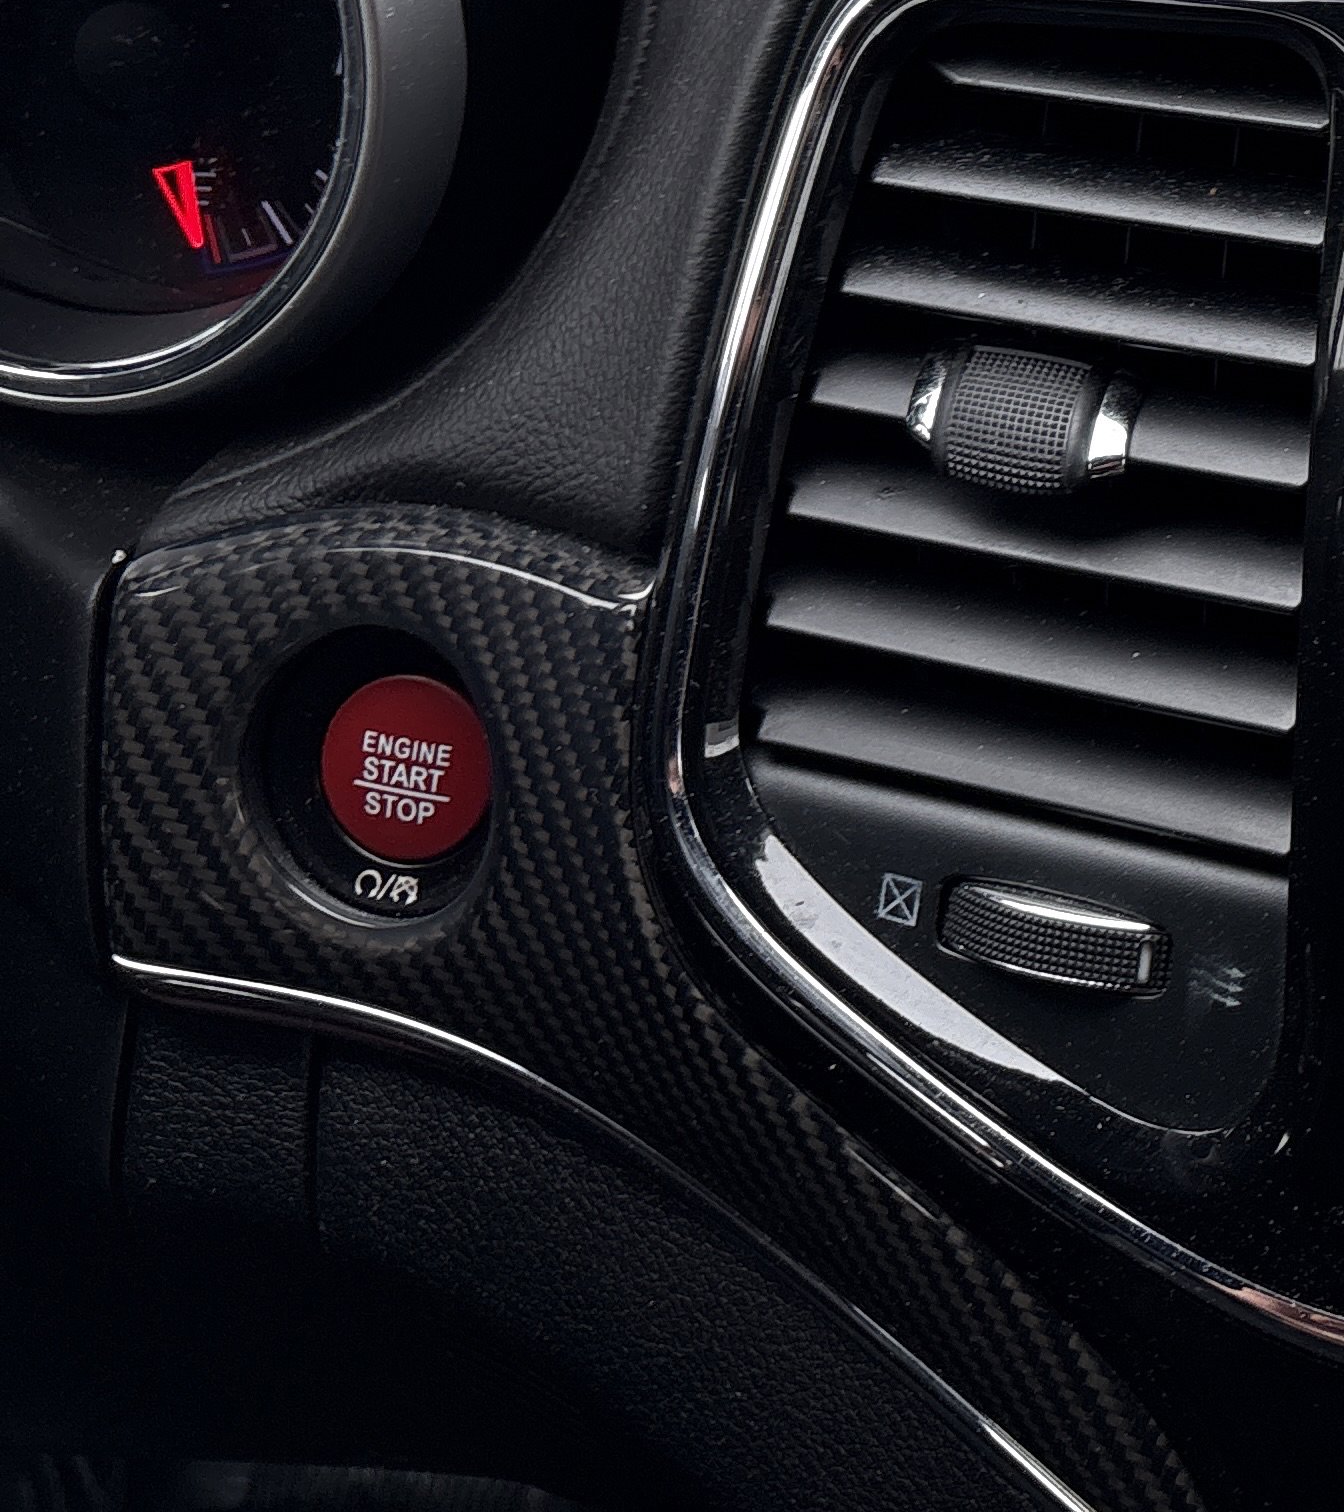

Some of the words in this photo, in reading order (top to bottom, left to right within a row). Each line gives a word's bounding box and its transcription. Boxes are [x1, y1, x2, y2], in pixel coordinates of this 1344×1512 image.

[362, 730, 452, 767] ENGINE
[363, 756, 444, 792] START
[365, 792, 435, 824] STOP
